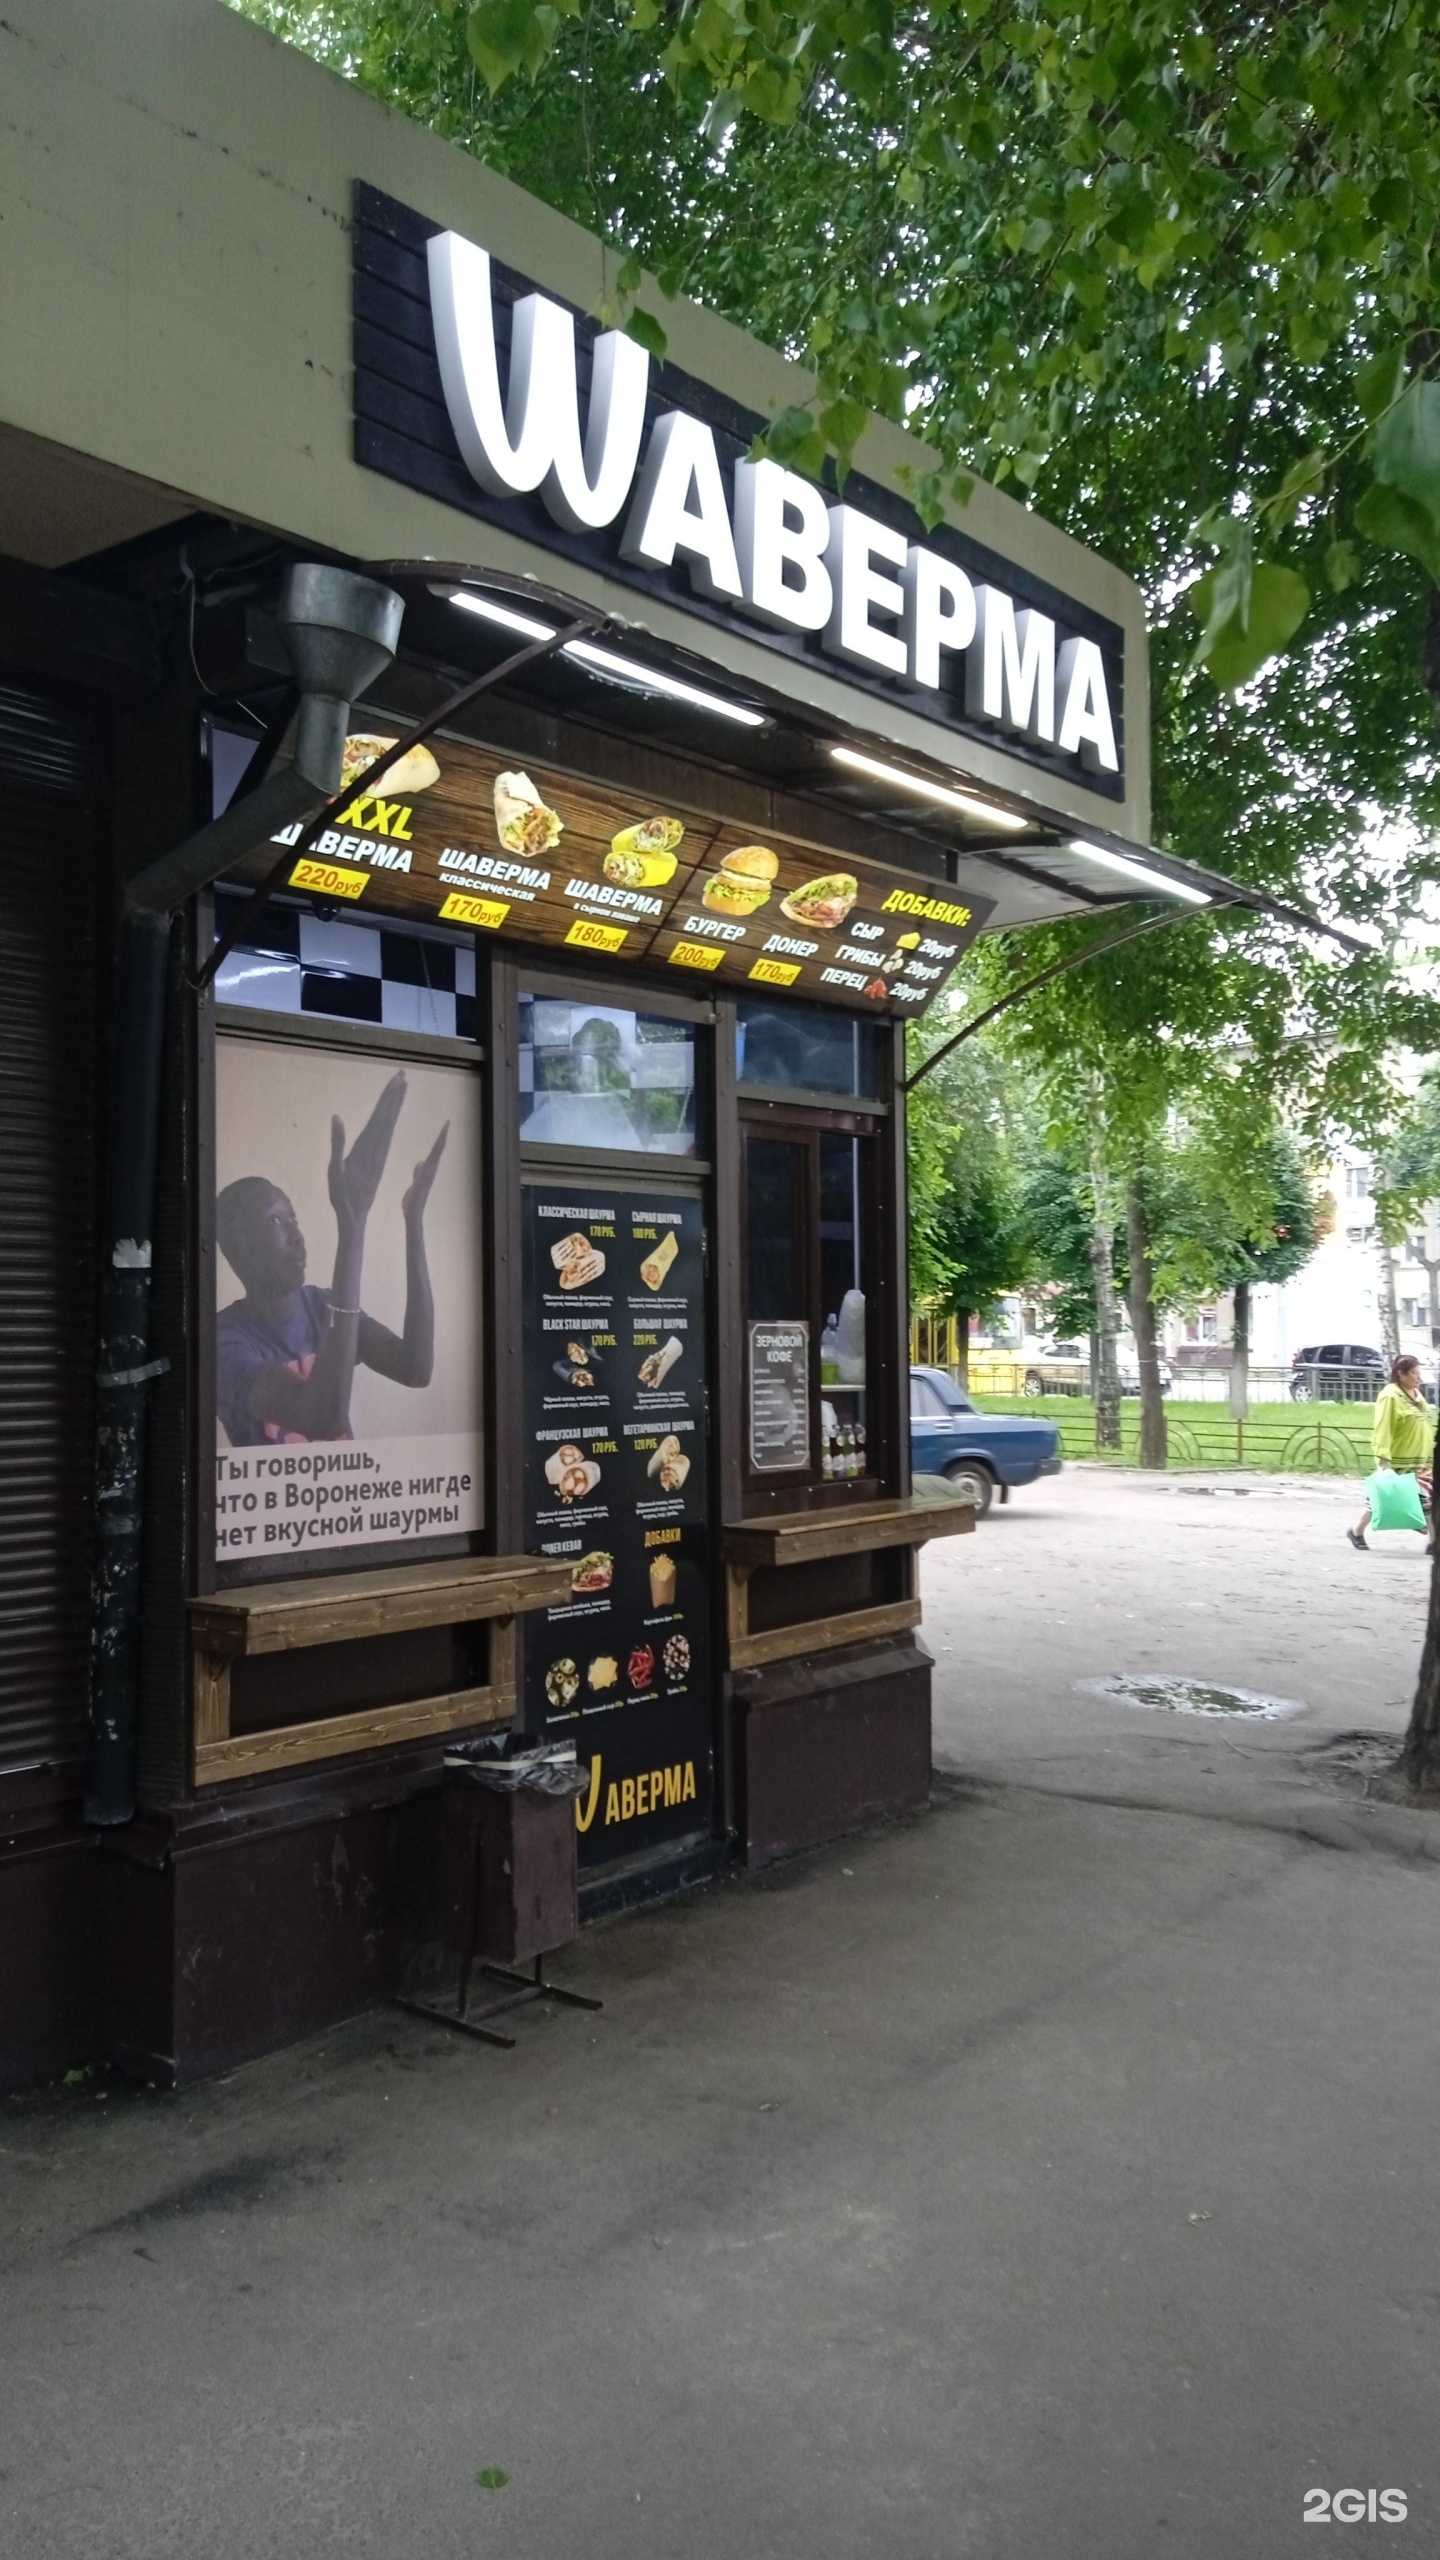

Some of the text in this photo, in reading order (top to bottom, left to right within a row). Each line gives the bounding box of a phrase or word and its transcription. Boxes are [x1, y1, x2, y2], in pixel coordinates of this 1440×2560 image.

[335, 795, 413, 841] XXL
[270, 823, 413, 873] ШВЕРМА
[296, 864, 363, 895] 220руб
[438, 848, 551, 890] ШАВЕРМА
[439, 873, 536, 901] классическая
[564, 878, 663, 916] ШАВЕРМА
[450, 898, 503, 924] 170руб
[881, 889, 972, 927] ДОБАВКИ:
[574, 924, 622, 948] 180руб
[684, 916, 746, 941] БУРГЕР
[762, 934, 819, 957] ДОНЕР
[851, 922, 958, 959] СЫР 20руб
[835, 945, 943, 980] ГРИБЫ 20руб
[820, 968, 929, 1002] ПЕРЕЦ 20руб
[766, 1351, 793, 1363] КОФЕ
[256, 1451, 381, 1481] говоришь,
[264, 1491, 278, 1510] в
[285, 1479, 403, 1513] Воронеже
[409, 1473, 472, 1498] нигде
[264, 1505, 364, 1548] вкусной
[369, 1503, 459, 1536] шаурмы
